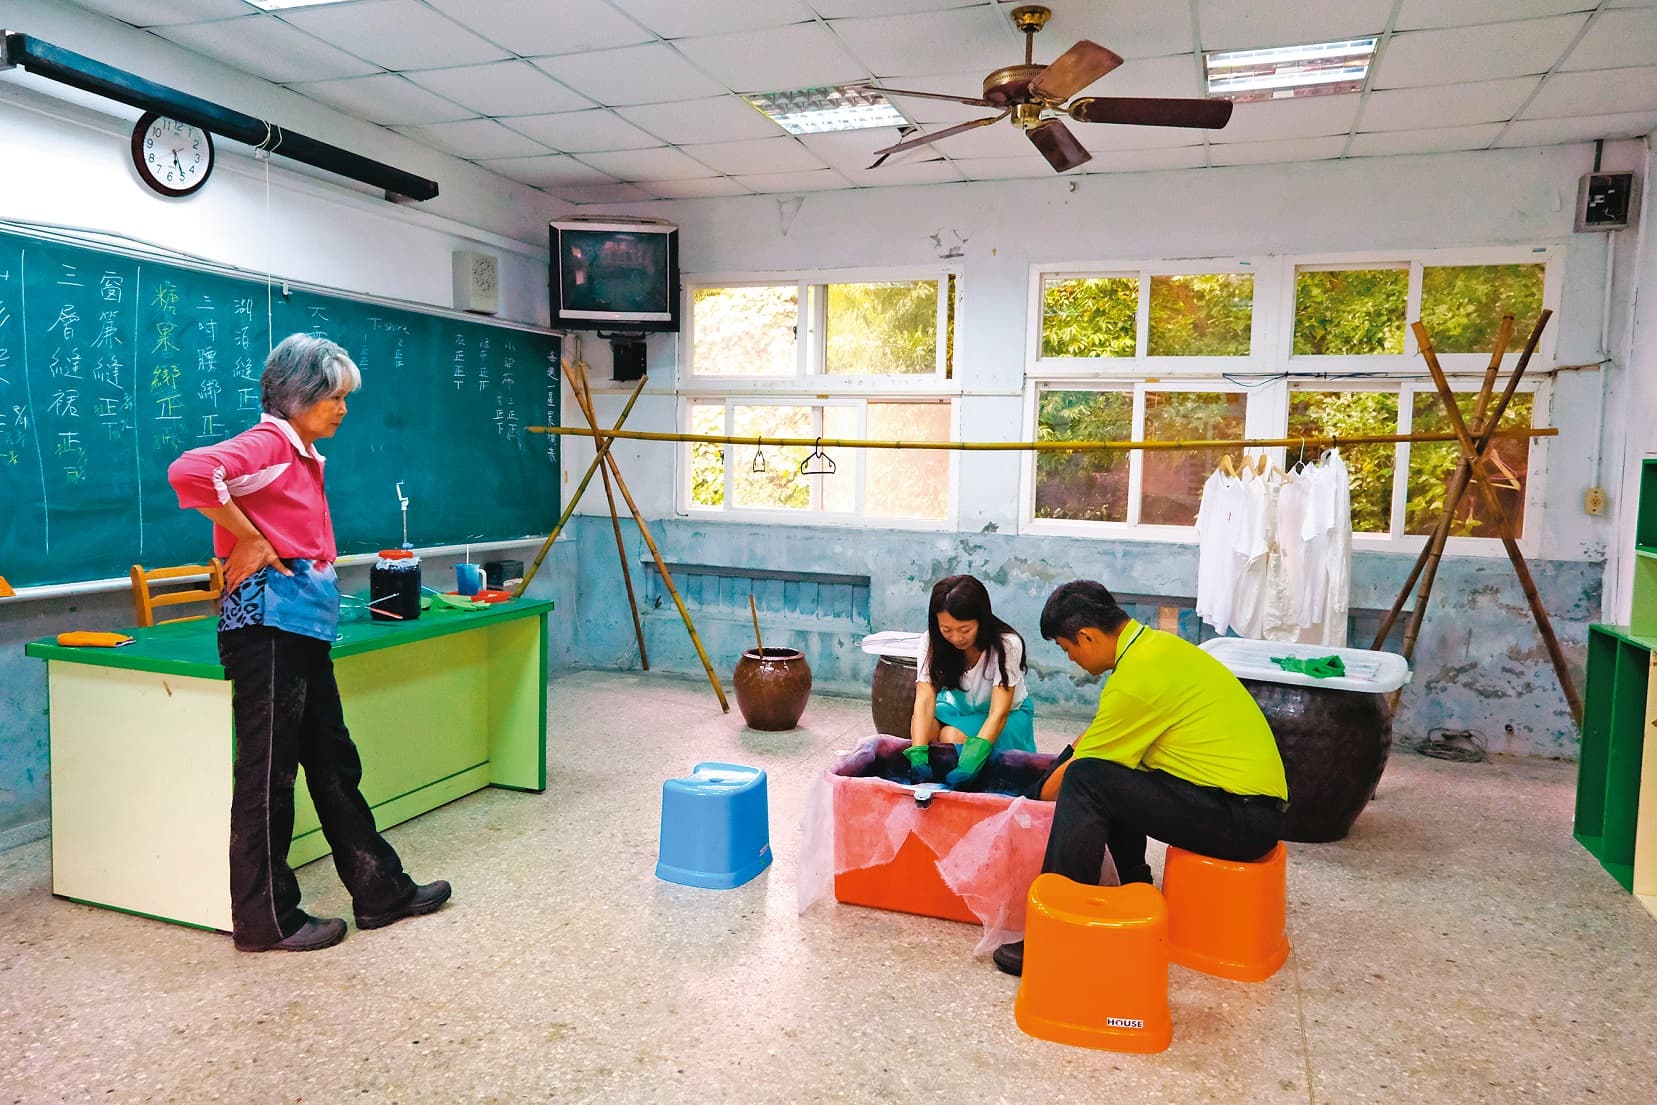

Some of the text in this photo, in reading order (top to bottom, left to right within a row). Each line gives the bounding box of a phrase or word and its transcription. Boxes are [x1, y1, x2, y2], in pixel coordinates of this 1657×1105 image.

[164, 120, 171, 131] 11
[175, 121, 184, 131] 12
[153, 127, 162, 138] 10
[147, 138, 153, 149] 9
[192, 140, 199, 150] 2
[148, 153, 155, 163] 8
[194, 153, 200, 163] 3
[156, 164, 162, 174] 7
[189, 165, 195, 174] 4
[167, 172, 173, 182] 6
[179, 172, 186, 182] 5
[1107, 1018, 1143, 1028] HOUSE
